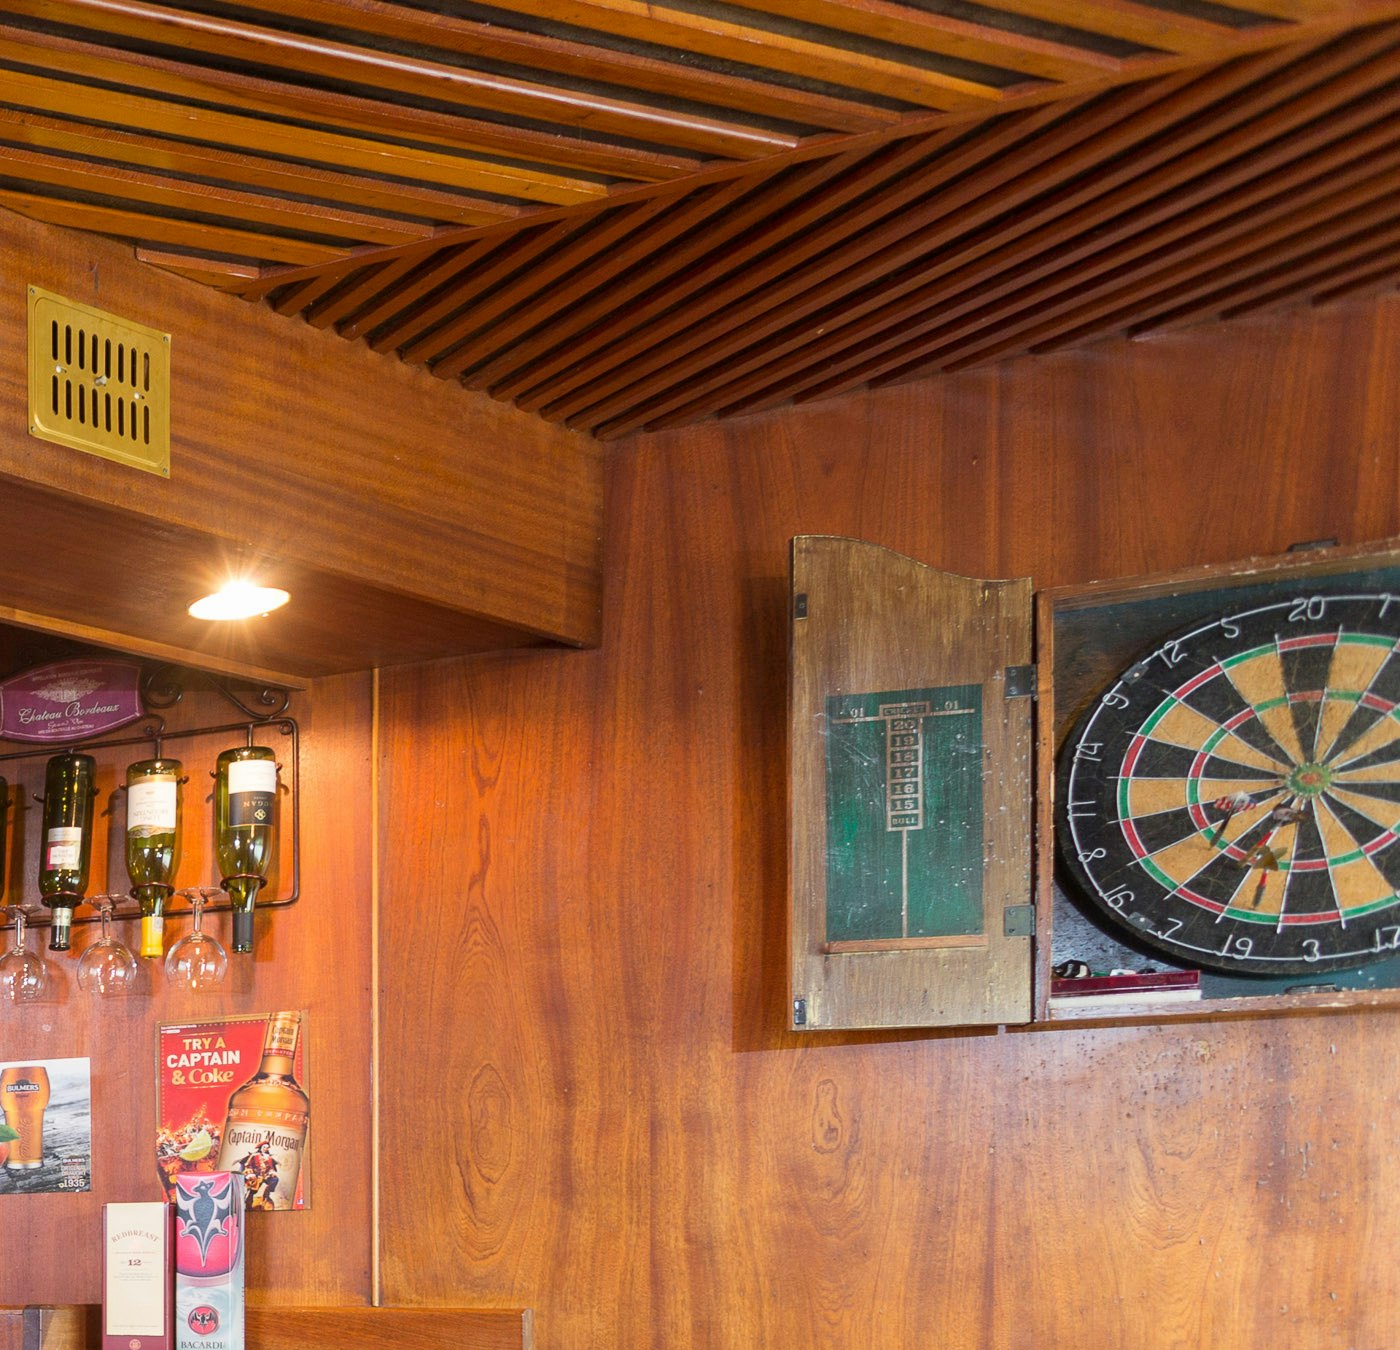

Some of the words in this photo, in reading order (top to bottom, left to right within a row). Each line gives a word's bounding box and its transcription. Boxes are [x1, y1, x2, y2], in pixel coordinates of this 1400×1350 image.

[1288, 596, 1325, 621] 20
[1220, 618, 1240, 639] 5
[1157, 640, 1188, 669] 12
[1102, 692, 1130, 710] 9
[18, 707, 62, 724] Chateau
[65, 702, 120, 718] Bordeaux
[893, 720, 915, 731] 20
[895, 736, 914, 746] 19
[895, 752, 914, 762] 18
[1076, 743, 1103, 763] 14
[895, 768, 914, 778] 17
[895, 784, 914, 795] 16
[895, 800, 914, 811] 15
[1068, 800, 1096, 820] 11
[1078, 847, 1107, 863] 8
[1100, 883, 1135, 909] 16
[1217, 933, 1254, 959] 19
[1302, 939, 1320, 962] 3
[183, 1038, 212, 1051] TRY
[215, 1037, 226, 1049] A
[166, 1050, 241, 1069] CAPTAIN
[171, 1071, 187, 1086] &
[188, 1067, 235, 1085] Coke
[7, 1084, 39, 1093] BULMERS
[228, 1128, 262, 1146] Captain
[263, 1129, 299, 1150] Morgan
[64, 1179, 85, 1188] 1935
[111, 1230, 160, 1243] REDBREAST
[180, 1341, 224, 1350] BACARDI
